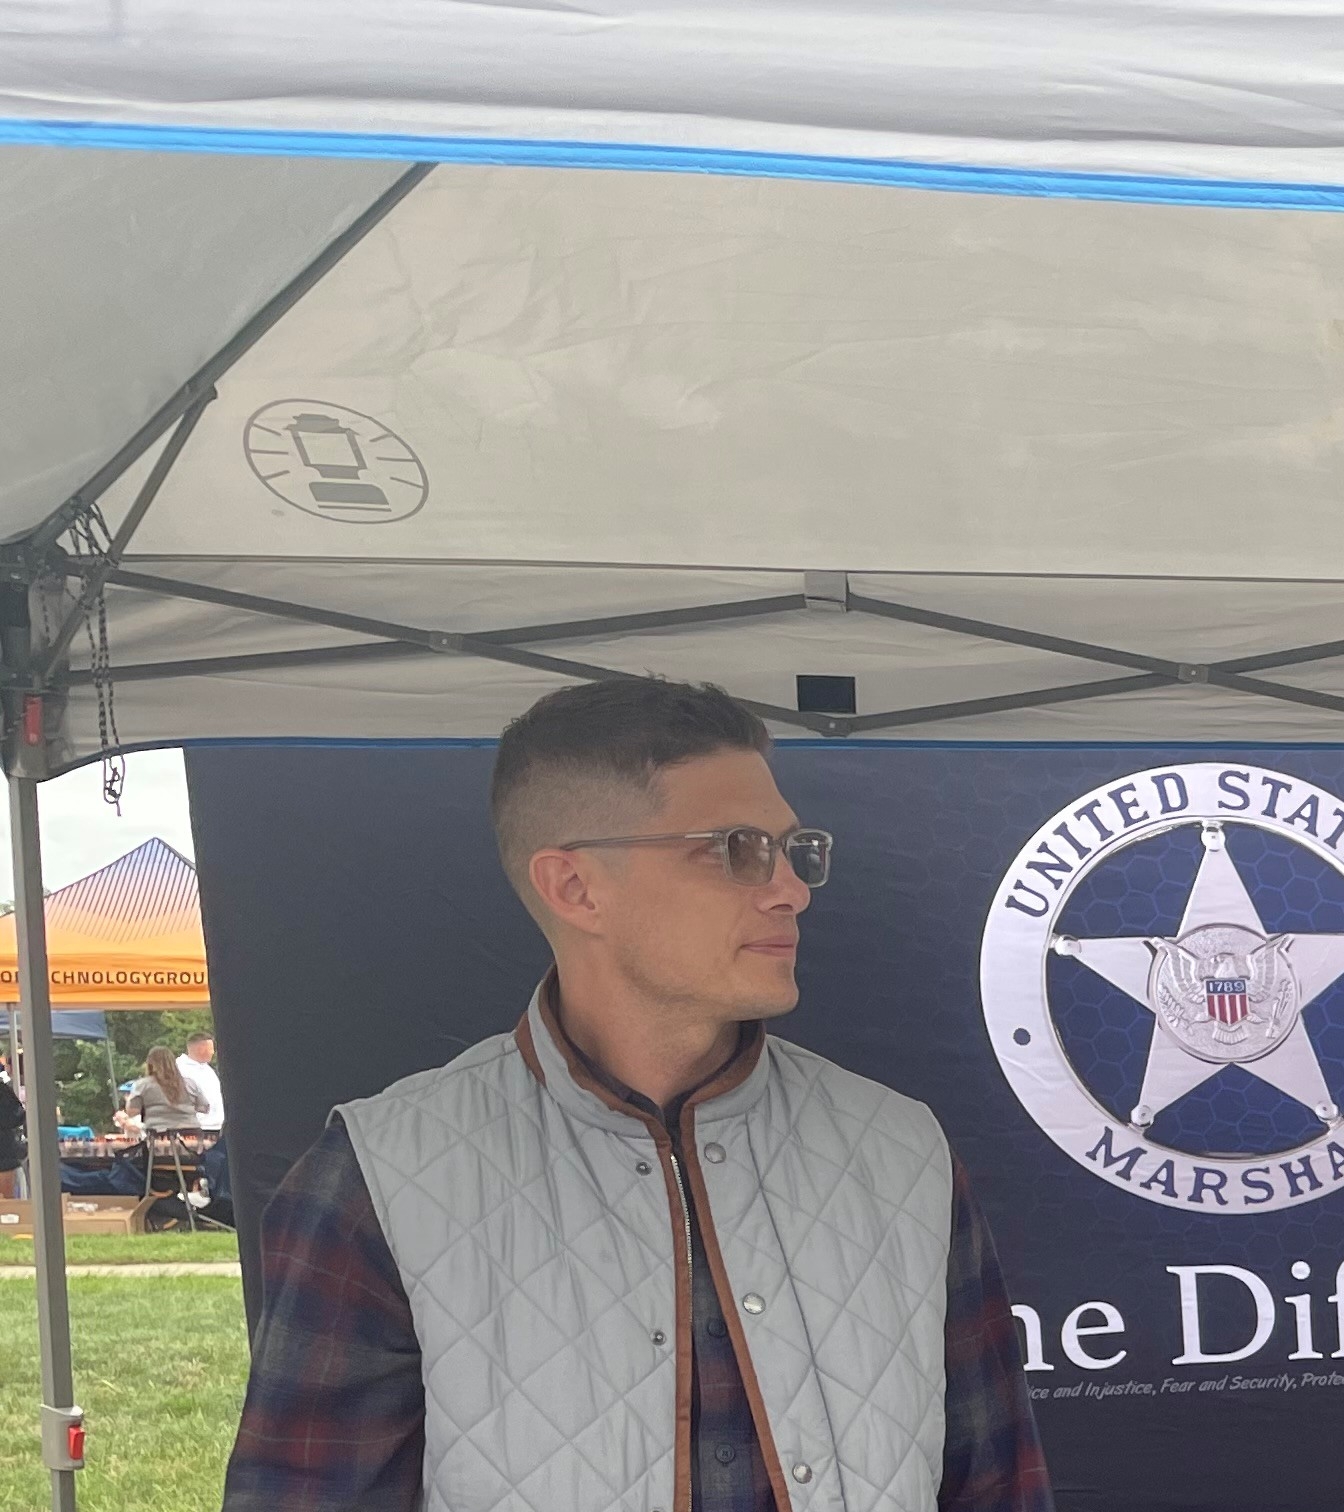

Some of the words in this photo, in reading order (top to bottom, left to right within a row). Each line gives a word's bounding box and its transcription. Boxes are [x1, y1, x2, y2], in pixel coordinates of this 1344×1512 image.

[1004, 770, 1189, 918] UNITED
[51, 971, 205, 985] CHNOLOGYGROU
[1209, 981, 1245, 993] 1789
[1028, 1385, 1050, 1400] ice
[1053, 1381, 1081, 1398] and
[1083, 1380, 1157, 1400] Injustice,
[1160, 1378, 1196, 1394] Fear
[1199, 1375, 1229, 1392] and
[1229, 1373, 1297, 1392] Security,
